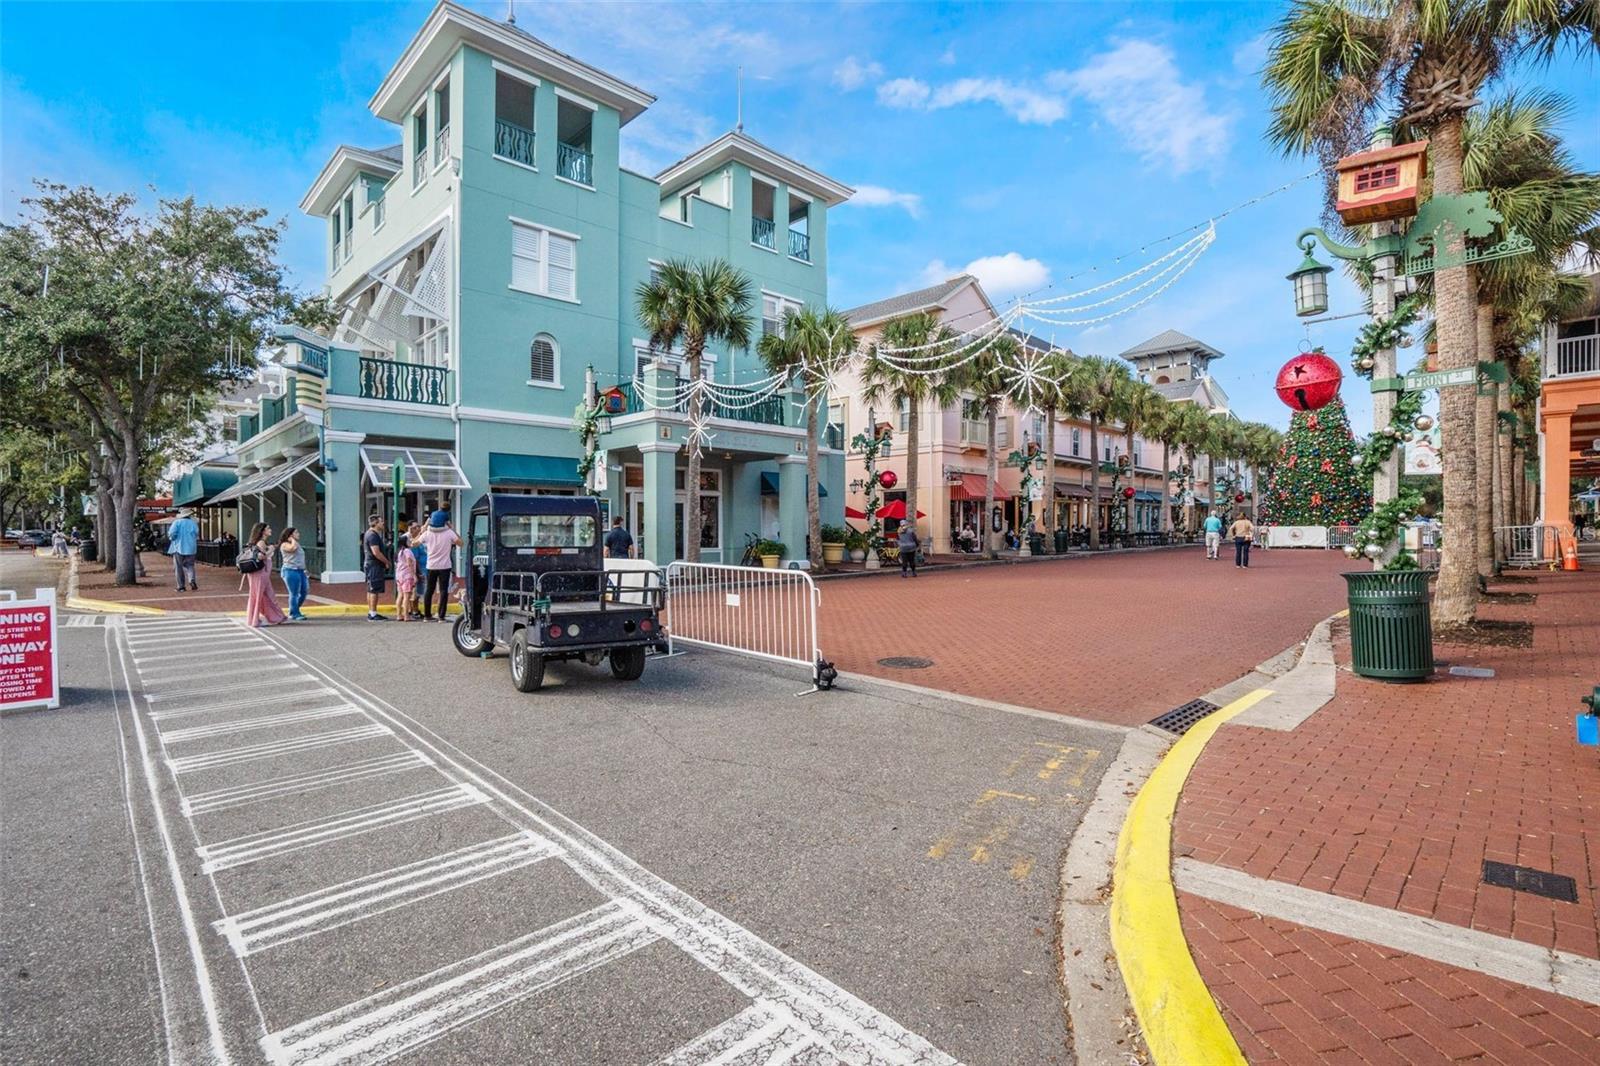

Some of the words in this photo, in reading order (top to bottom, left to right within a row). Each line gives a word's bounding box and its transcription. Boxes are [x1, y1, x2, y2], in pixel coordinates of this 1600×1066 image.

[1414, 373, 1452, 387] FRONT
[0, 612, 46, 624] NING
[0, 641, 48, 653] AWAY
[0, 653, 25, 664] NE
[3, 690, 36, 699] EXPENSE
